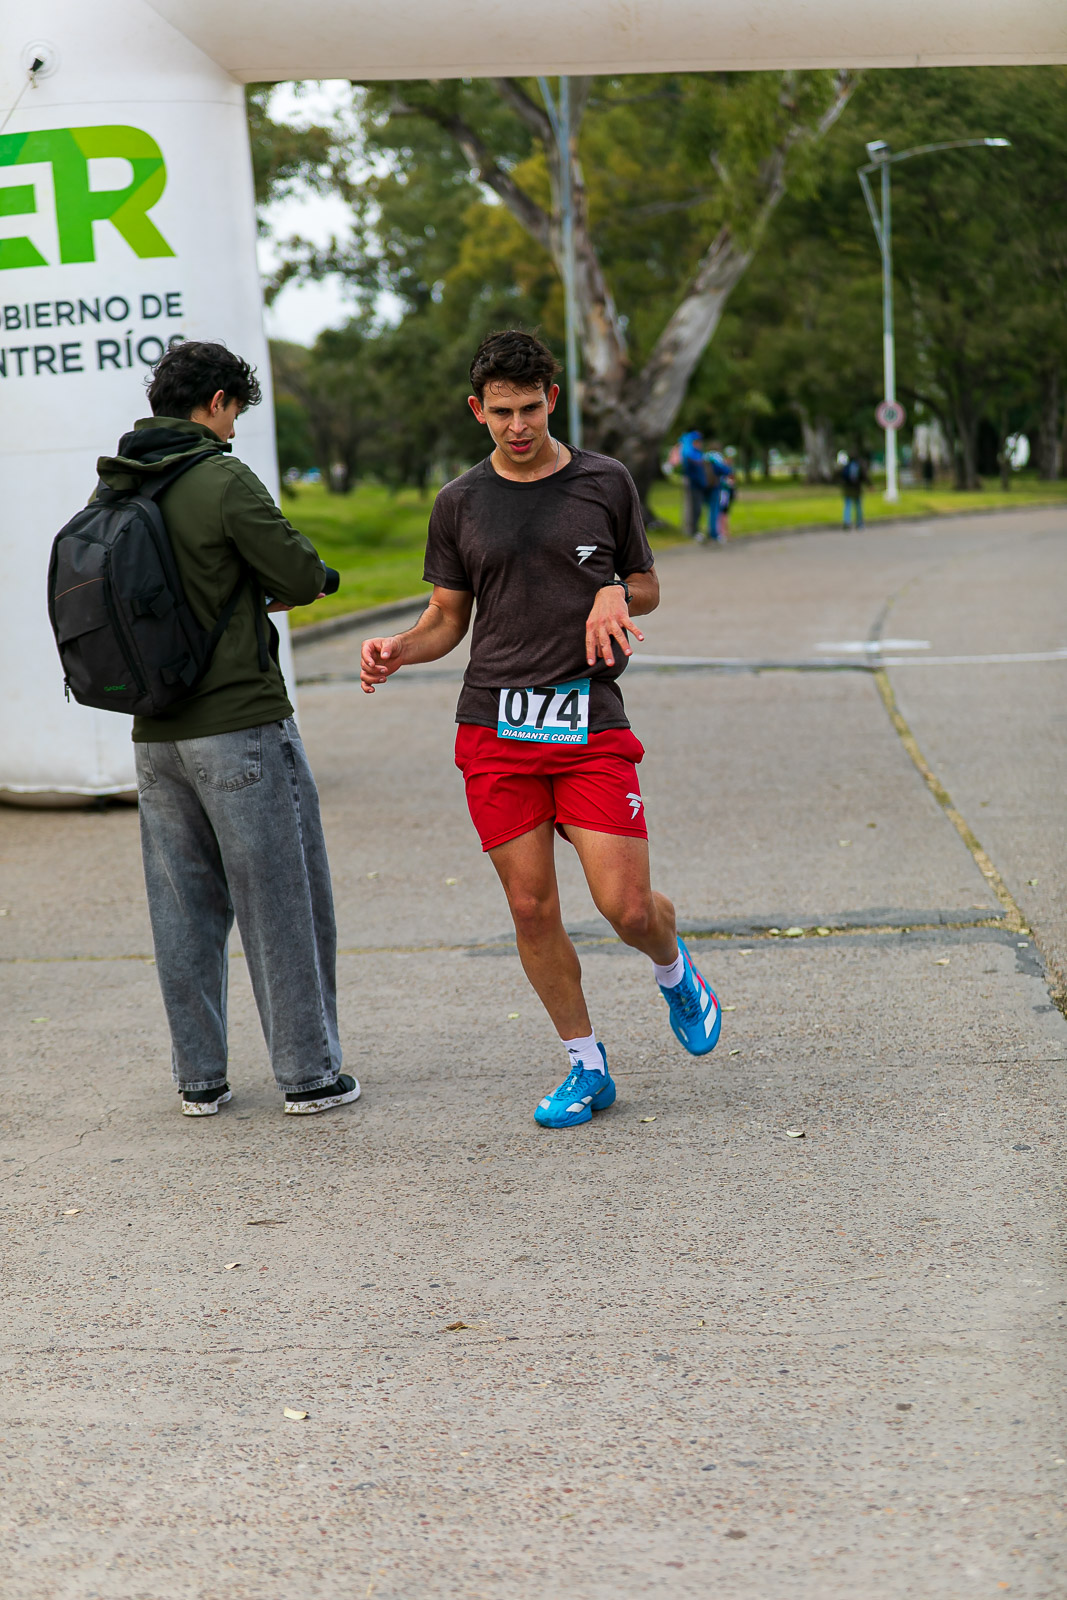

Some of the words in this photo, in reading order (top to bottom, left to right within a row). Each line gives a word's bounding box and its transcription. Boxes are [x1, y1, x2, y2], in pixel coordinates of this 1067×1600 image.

[0, 296, 129, 331] BIERNO
[141, 292, 183, 319] DE
[0, 342, 84, 378] TRE
[504, 687, 582, 731] 074
[501, 729, 550, 741] DIAMANTE
[551, 733, 583, 742] CORRE
